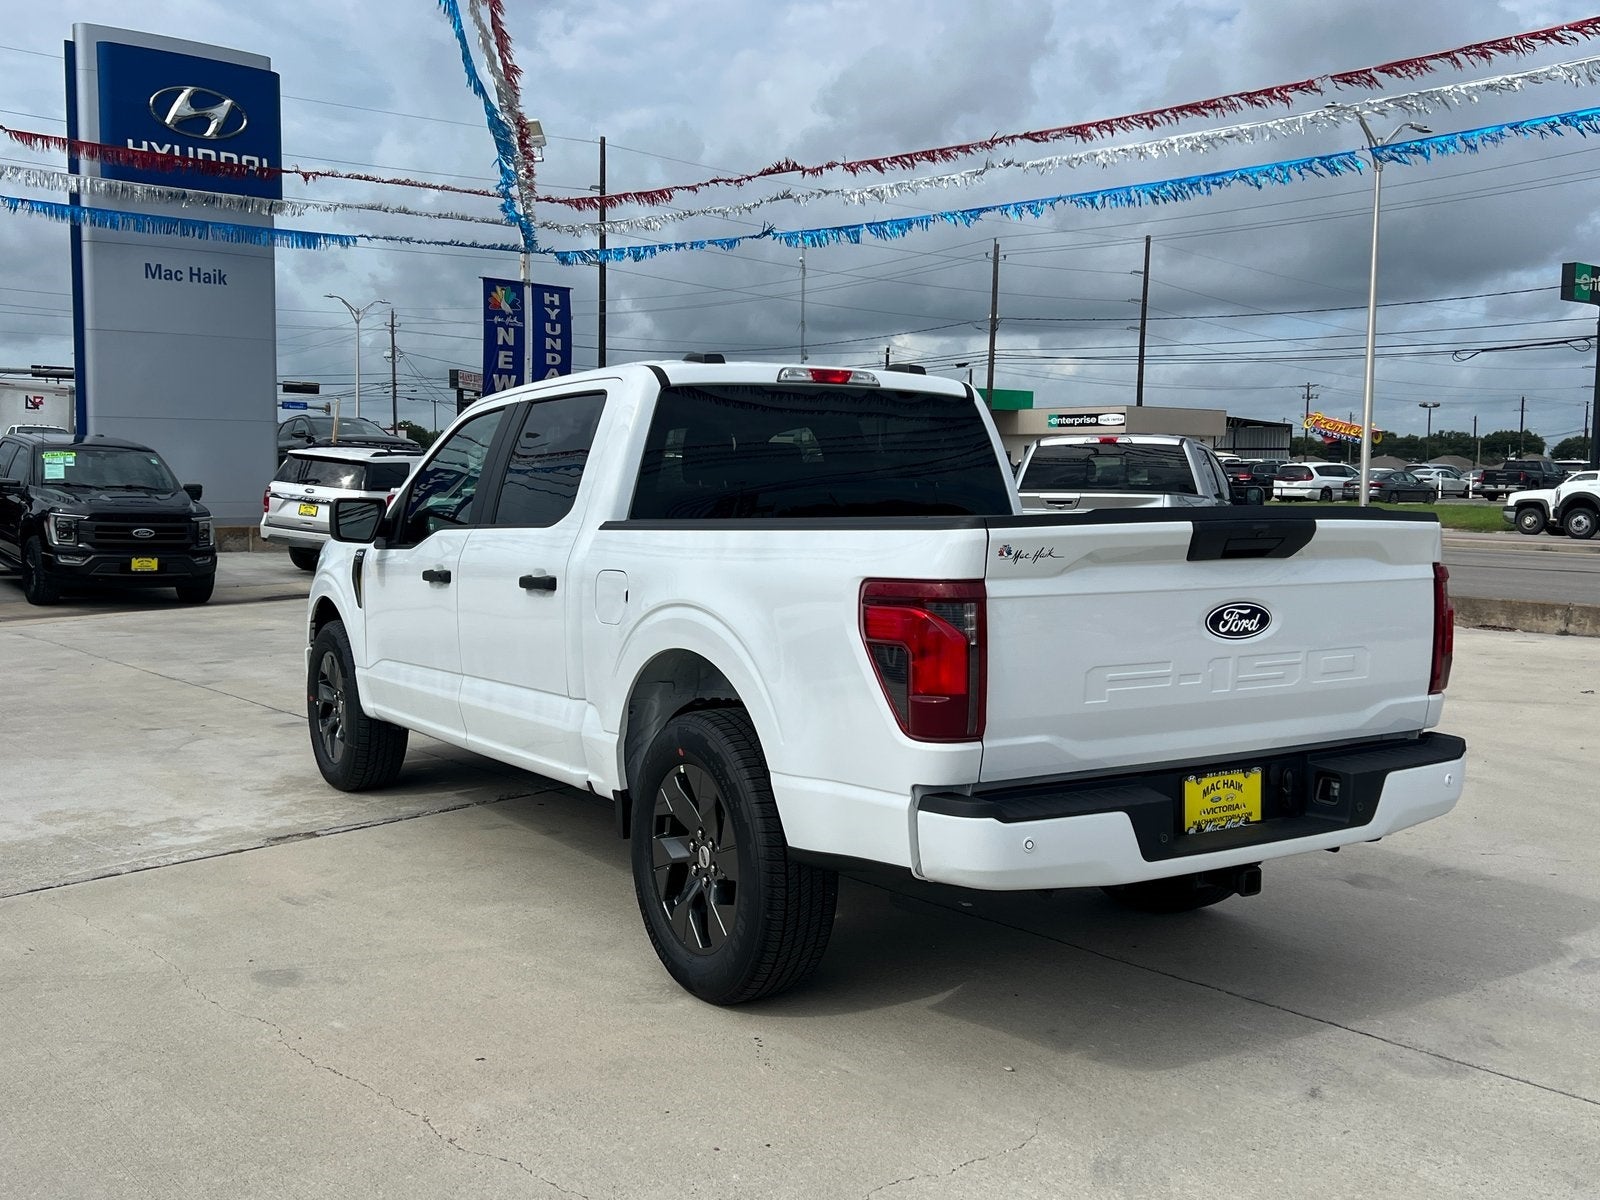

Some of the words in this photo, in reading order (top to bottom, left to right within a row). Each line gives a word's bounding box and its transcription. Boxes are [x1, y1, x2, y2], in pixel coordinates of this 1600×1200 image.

[145, 262, 184, 282] Mac
[189, 266, 228, 286] Haik
[493, 326, 517, 393] NEW
[1048, 415, 1097, 426] enterprise
[1010, 549, 1031, 565] Mac
[1032, 546, 1064, 564] Haik
[1218, 608, 1261, 633] Ford
[1084, 645, 1370, 704] F-150
[1202, 780, 1221, 799] MAC
[1222, 779, 1244, 793] HAIK
[1205, 802, 1241, 815] VICTORIA
[1204, 821, 1224, 833] Mac
[1224, 817, 1247, 829] Haik
